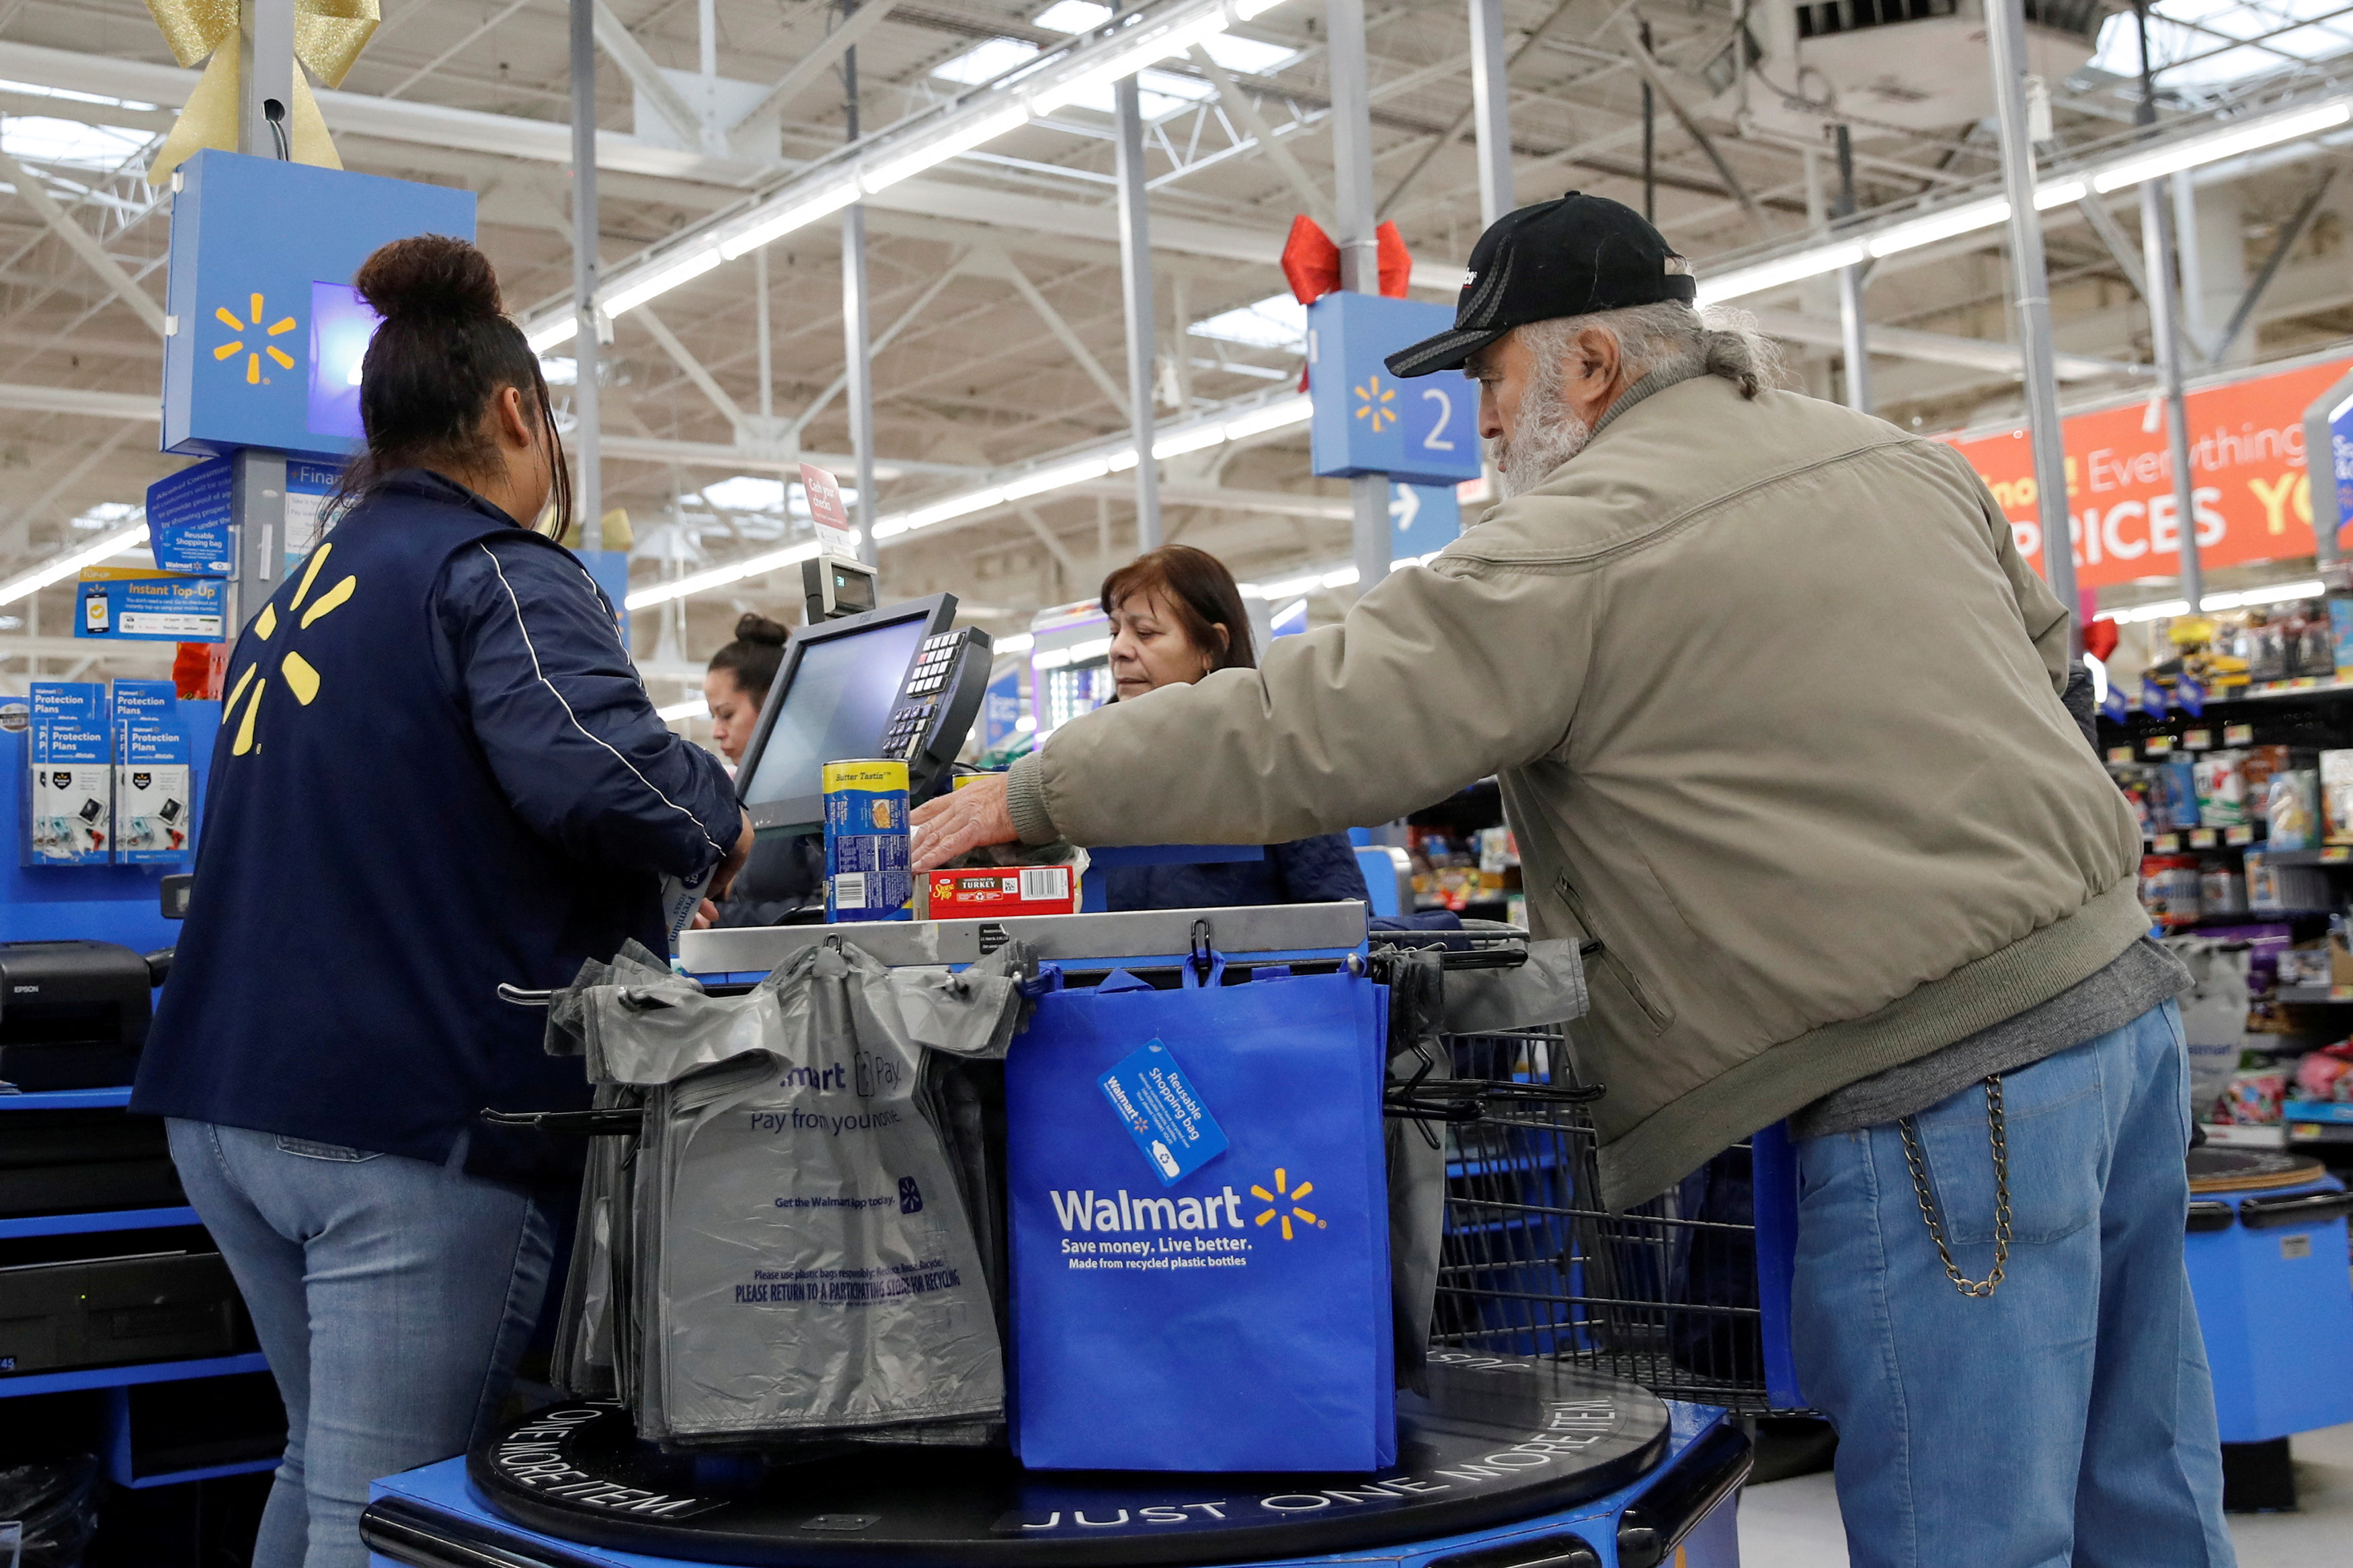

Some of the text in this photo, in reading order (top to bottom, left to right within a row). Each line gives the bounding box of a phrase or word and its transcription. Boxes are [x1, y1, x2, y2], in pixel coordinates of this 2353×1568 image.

[1423, 388, 1454, 451] 2
[184, 531, 214, 540] Reusable
[176, 538, 208, 548] Shopping
[209, 540, 223, 548] bag
[165, 561, 193, 569] Walmart
[129, 583, 216, 598] Instant Top-Up
[35, 696, 83, 704] Protection
[118, 696, 165, 706] Protection
[35, 705, 59, 714] Plans
[117, 706, 141, 714] Plans
[52, 731, 102, 741] Protection
[132, 733, 180, 742] Protection
[52, 741, 77, 750] Plans
[132, 742, 156, 751] Plans
[933, 884, 955, 898] Stove
[962, 880, 995, 889] TURKEY
[941, 891, 953, 901] Top
[673, 893, 687, 915] FORKS
[668, 896, 696, 942] Premium
[1107, 1076, 1139, 1120] Walmart
[1167, 1072, 1202, 1120] Reusable
[1149, 1067, 1186, 1119] Shopping
[1183, 1116, 1200, 1141] bag
[751, 1112, 786, 1134] Pay
[775, 1198, 793, 1208] Get
[794, 1197, 809, 1207] the
[868, 1195, 895, 1207] today.
[1049, 1186, 1244, 1232] Walmart
[1061, 1237, 1252, 1255] Save money. Live better.
[1069, 1255, 1246, 1270] Made from recycled plastic bottles
[754, 1270, 779, 1280] Please
[795, 1269, 818, 1281] plastic
[820, 1268, 838, 1280] bags
[735, 1284, 768, 1303] PLEASE
[771, 1283, 805, 1301] RETURN
[807, 1283, 818, 1300] TO
[821, 1283, 827, 1300] A
[887, 1277, 912, 1296] STORE
[910, 1274, 925, 1294] FOR
[925, 1268, 961, 1291] RECYCLING
[508, 1409, 604, 1440] ONE
[499, 1442, 590, 1485] MORE
[1022, 1501, 1227, 1530] JUST
[1260, 1477, 1451, 1511] ONE
[1434, 1433, 1600, 1481] MORE
